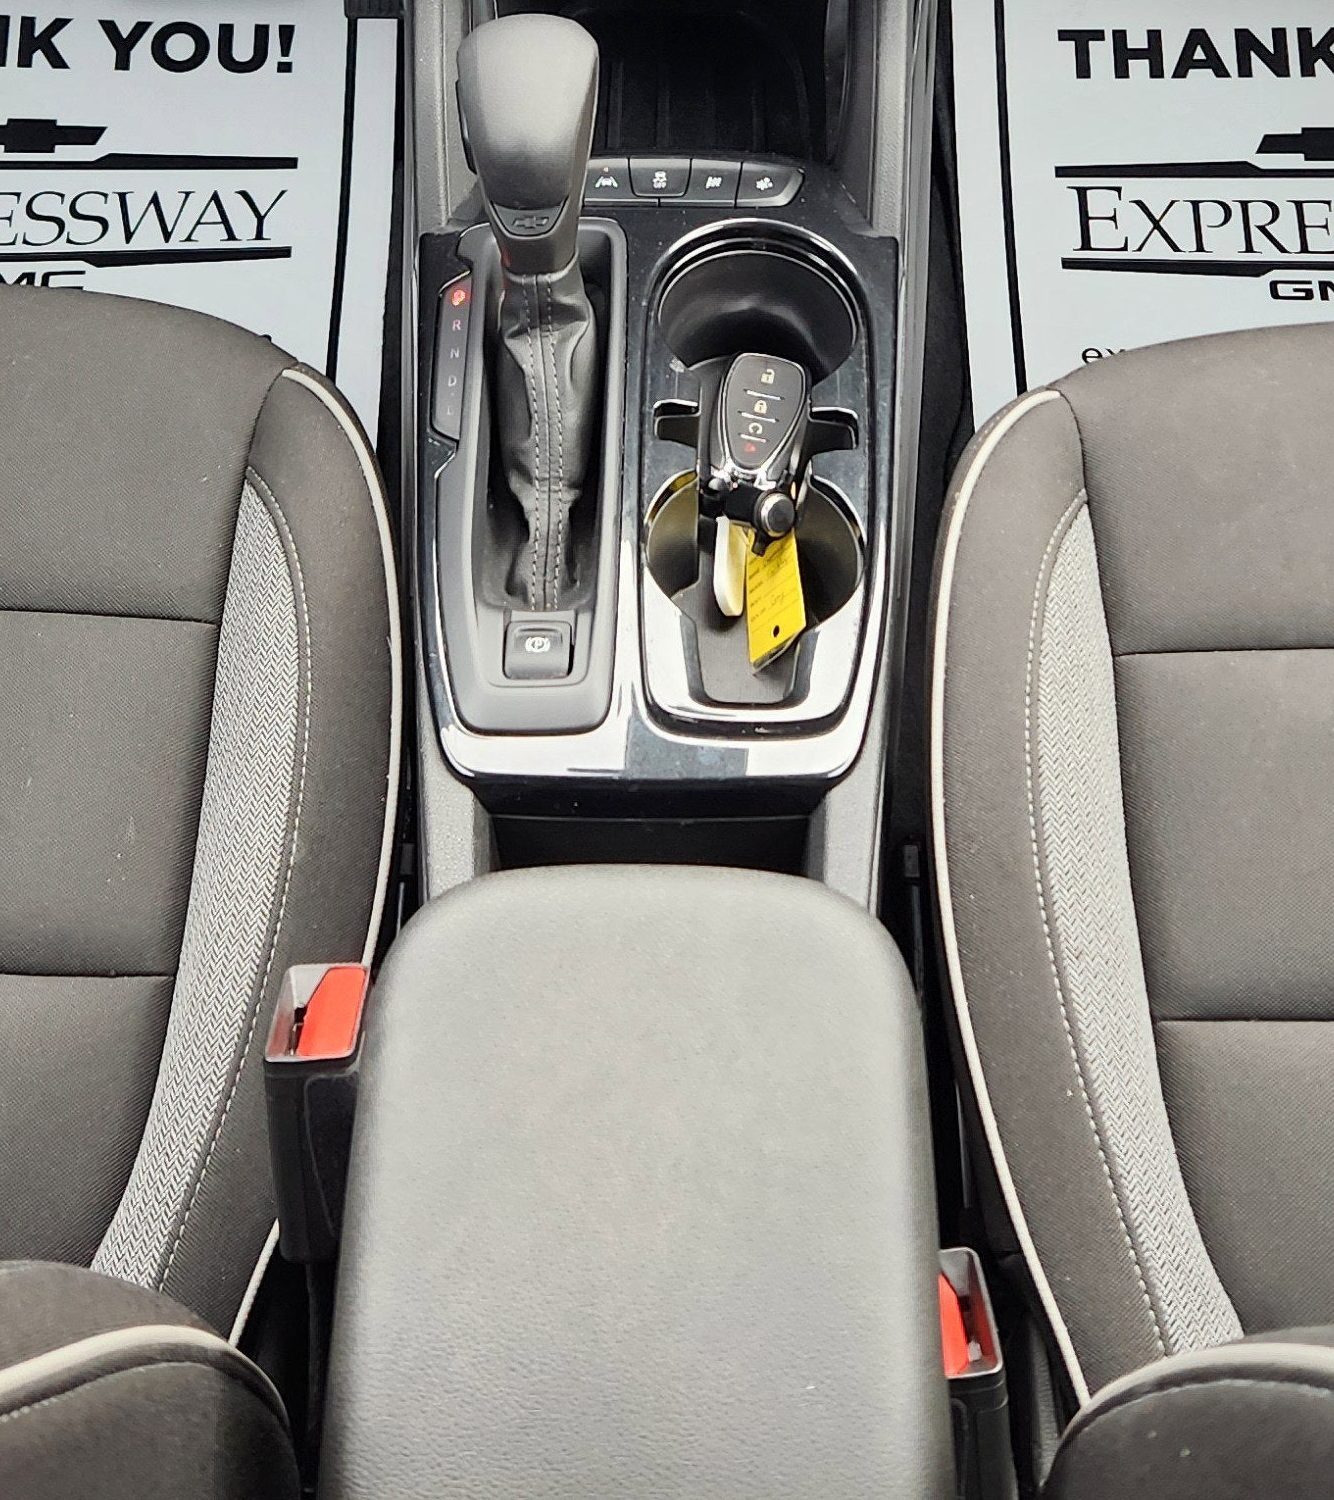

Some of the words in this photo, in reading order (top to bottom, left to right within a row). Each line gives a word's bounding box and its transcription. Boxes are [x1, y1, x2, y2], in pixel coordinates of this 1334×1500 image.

[98, 19, 296, 75] YOU!
[452, 319, 462, 332] R
[449, 349, 460, 359] N
[447, 376, 458, 387] D
